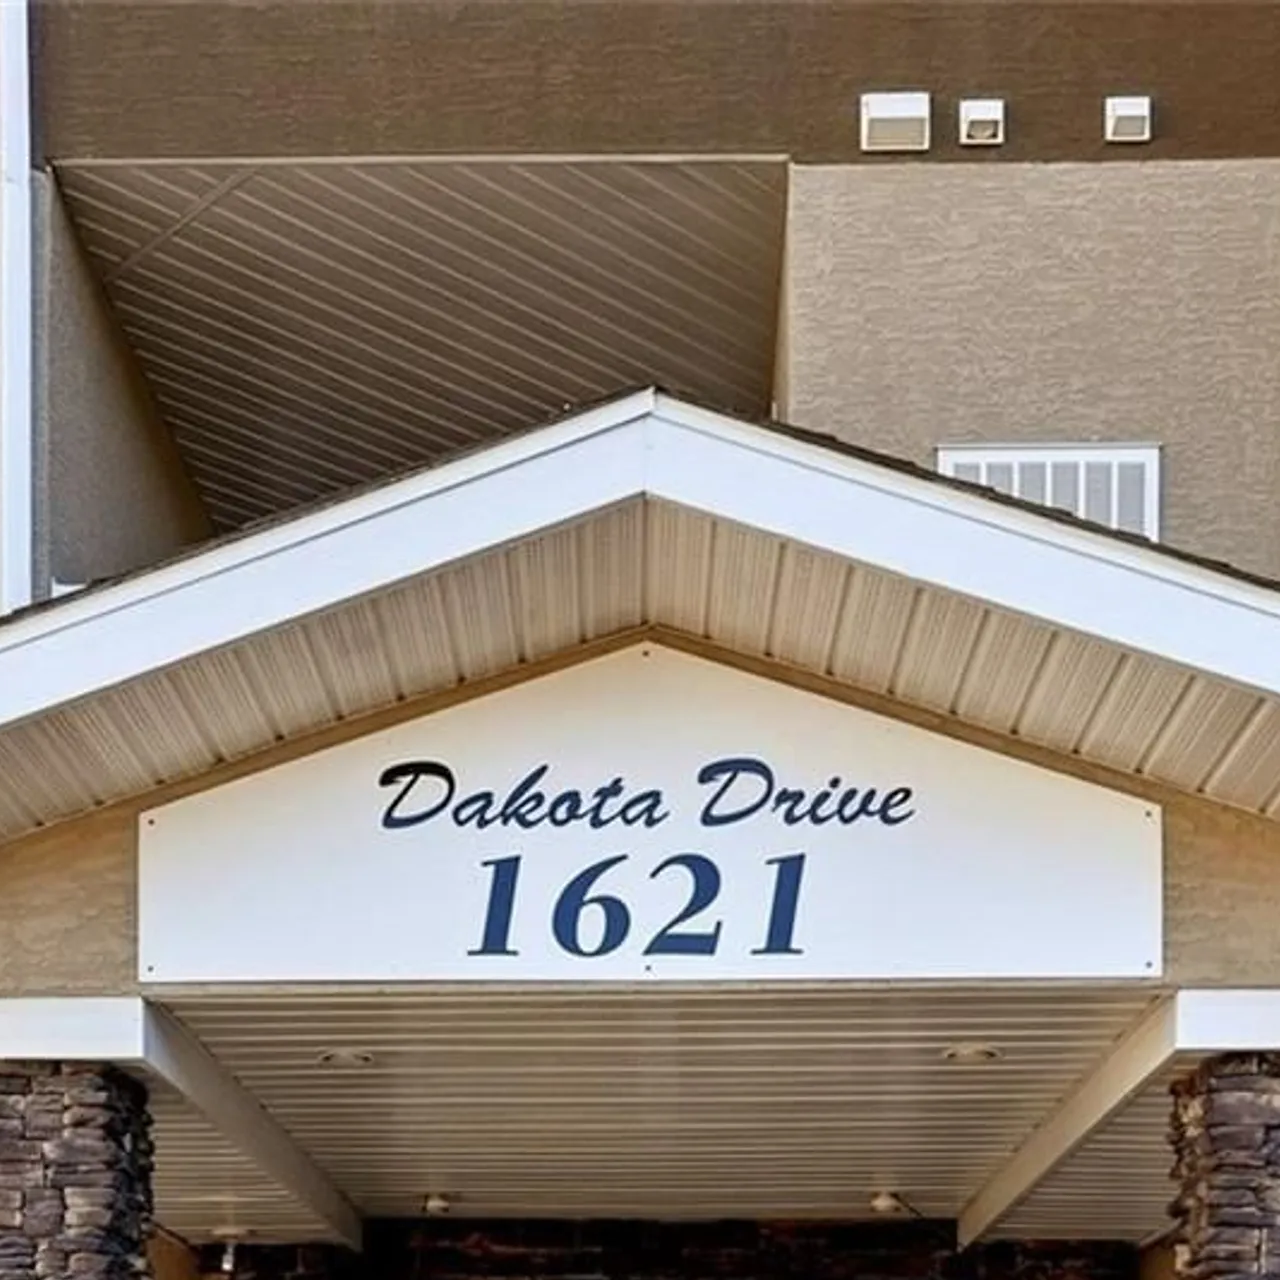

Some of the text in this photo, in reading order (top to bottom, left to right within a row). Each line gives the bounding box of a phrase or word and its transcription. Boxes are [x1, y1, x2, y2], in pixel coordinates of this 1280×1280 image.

[378, 757, 917, 830] Dakota Drive
[467, 852, 807, 959] 1621
